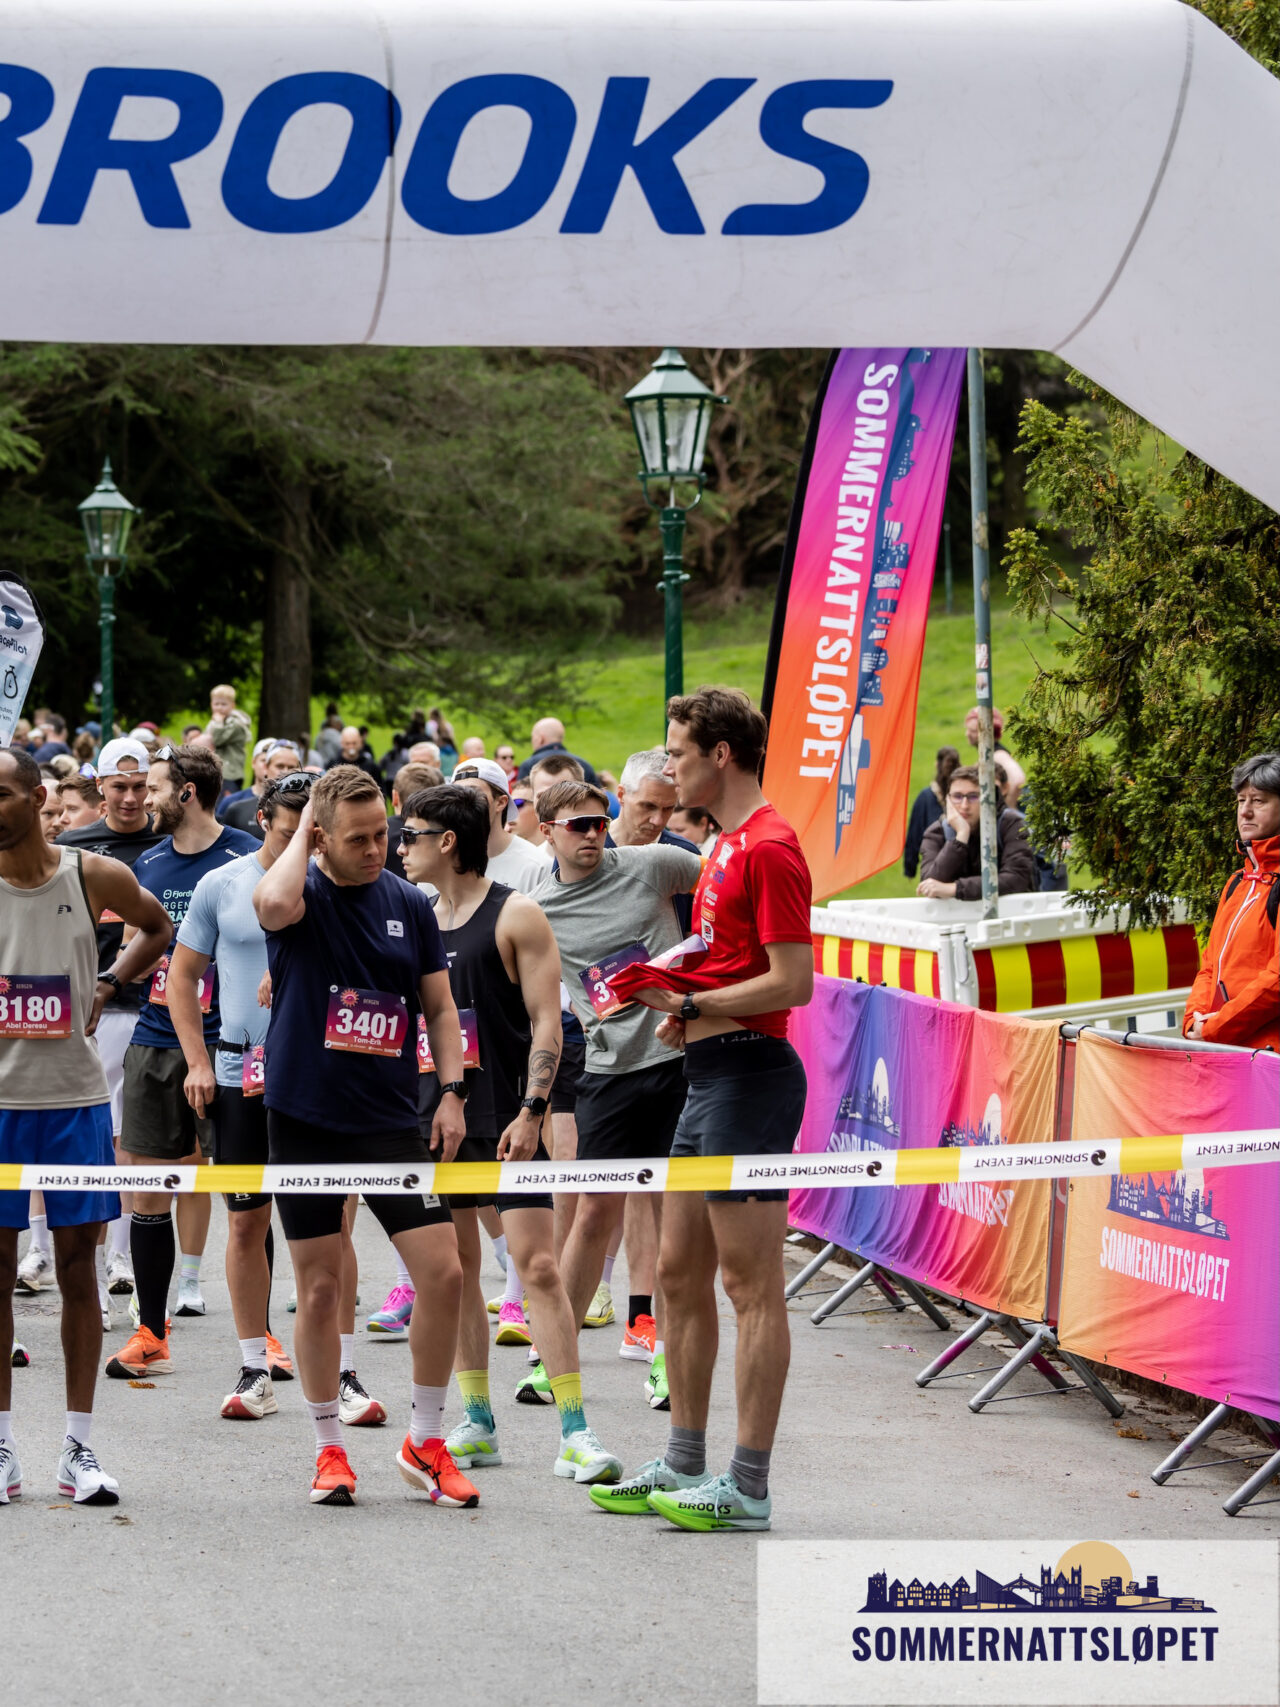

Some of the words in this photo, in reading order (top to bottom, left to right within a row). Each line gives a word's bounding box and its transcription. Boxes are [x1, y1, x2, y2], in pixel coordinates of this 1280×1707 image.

[798, 361, 900, 784] SOMMERNATTSLØPET
[335, 1007, 399, 1041] 3401
[1196, 1144, 1234, 1157] EVENT
[974, 1157, 1013, 1168] EVENT
[746, 1167, 787, 1178] EVENT
[38, 1175, 79, 1186] EVENT
[279, 1177, 321, 1188] EVENT
[515, 1174, 556, 1185] EVENT
[1099, 1226, 1230, 1302] SOMMERNATTSLØPET
